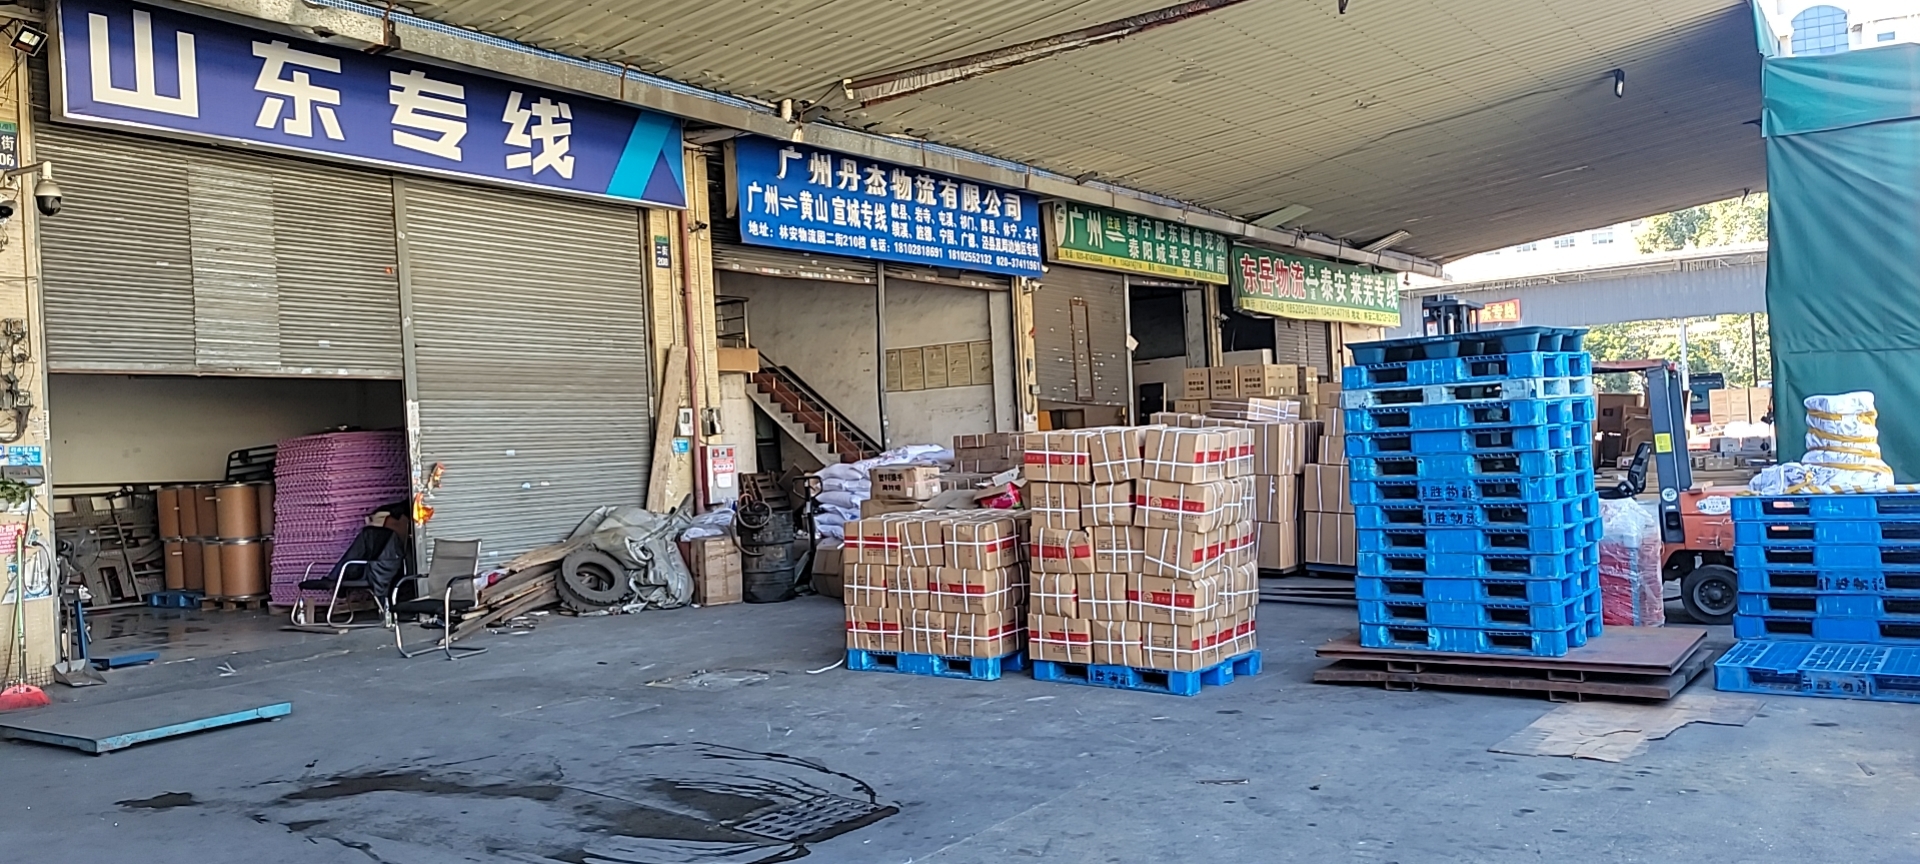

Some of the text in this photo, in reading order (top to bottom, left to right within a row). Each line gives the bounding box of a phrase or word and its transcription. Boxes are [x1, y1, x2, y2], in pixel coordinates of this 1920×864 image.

[88, 10, 575, 180] 山东专线
[747, 181, 889, 233] 广州 黄山 宣城专线
[776, 145, 1022, 222] 广州丹杰物流有限公司
[893, 242, 943, 259] 18102818691
[1069, 205, 1104, 249] 广州
[1240, 253, 1306, 299] 东岳物流
[1320, 266, 1348, 303] 泰安
[1350, 271, 1399, 310] 莱芜专线
